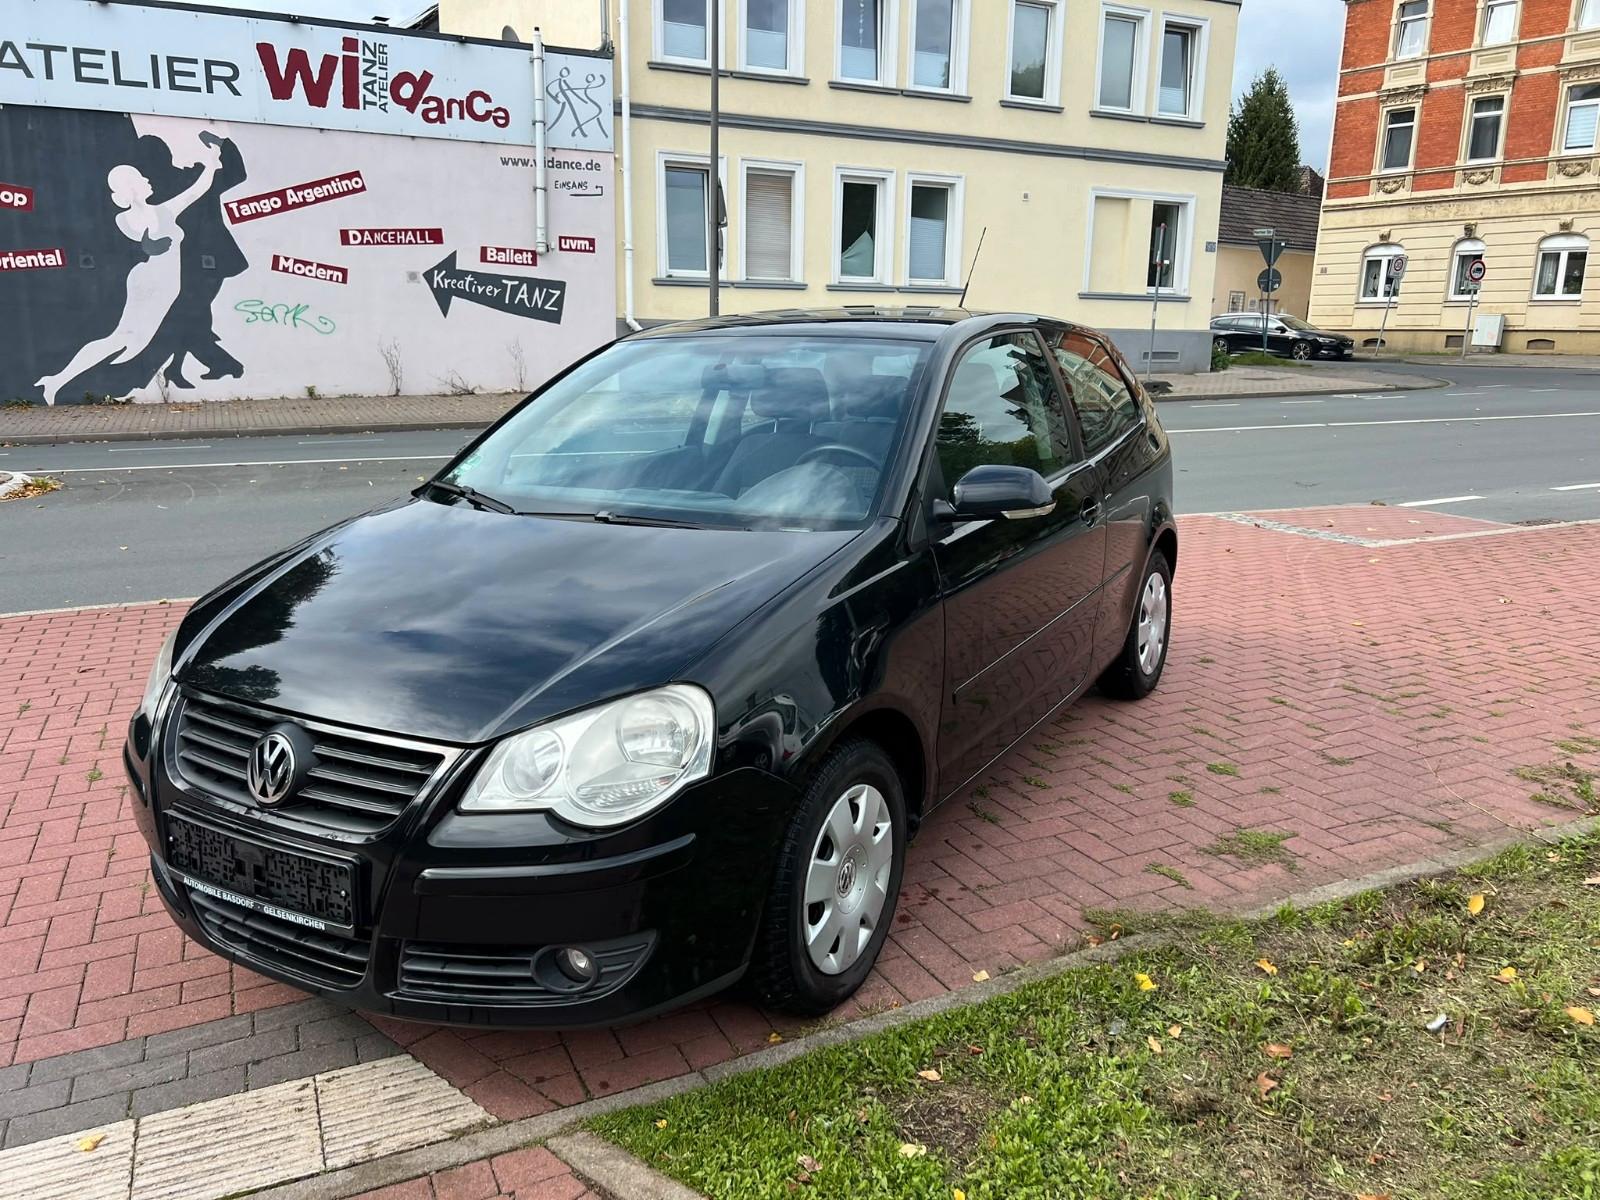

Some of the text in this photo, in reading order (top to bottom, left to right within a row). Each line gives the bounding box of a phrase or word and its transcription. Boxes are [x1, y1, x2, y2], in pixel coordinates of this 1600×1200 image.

[362, 40, 377, 111] TANZ
[378, 43, 389, 114] ATELIER
[228, 175, 364, 218] Tango Argentino
[348, 230, 434, 245] DANCEHALL
[486, 248, 533, 265] Ballett
[561, 238, 594, 251] uvm.
[278, 256, 343, 283] Modern
[433, 270, 561, 311] Kreativer TANZ
[183, 876, 326, 931] AUTOMOBILE BASDORF GELSENKIRCHEN
